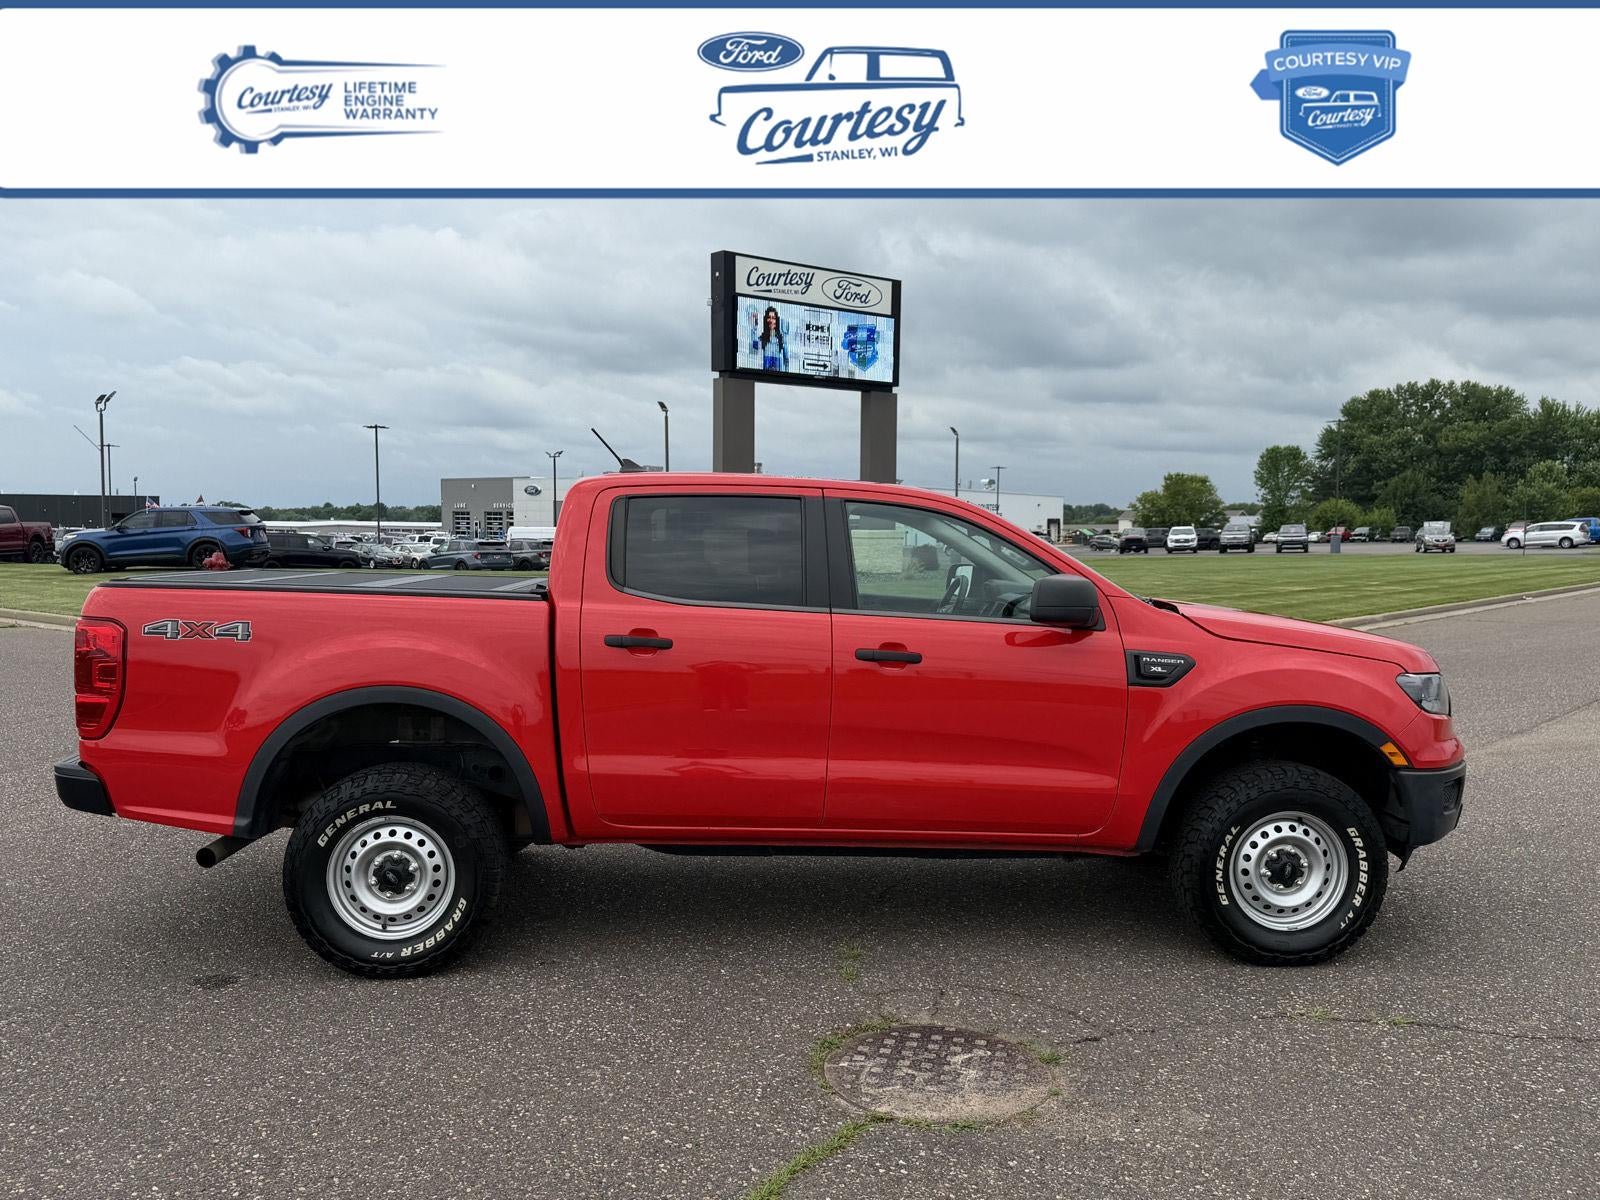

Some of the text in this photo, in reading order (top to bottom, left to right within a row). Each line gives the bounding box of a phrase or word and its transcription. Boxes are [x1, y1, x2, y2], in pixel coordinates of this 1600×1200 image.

[746, 266, 815, 295] Courtesy
[833, 280, 871, 304] Ford
[317, 800, 397, 848] GENERAL
[1215, 825, 1241, 906] GENERAL
[1340, 827, 1369, 930] GRABBER A/T
[371, 897, 467, 959] GRABBER A/T
